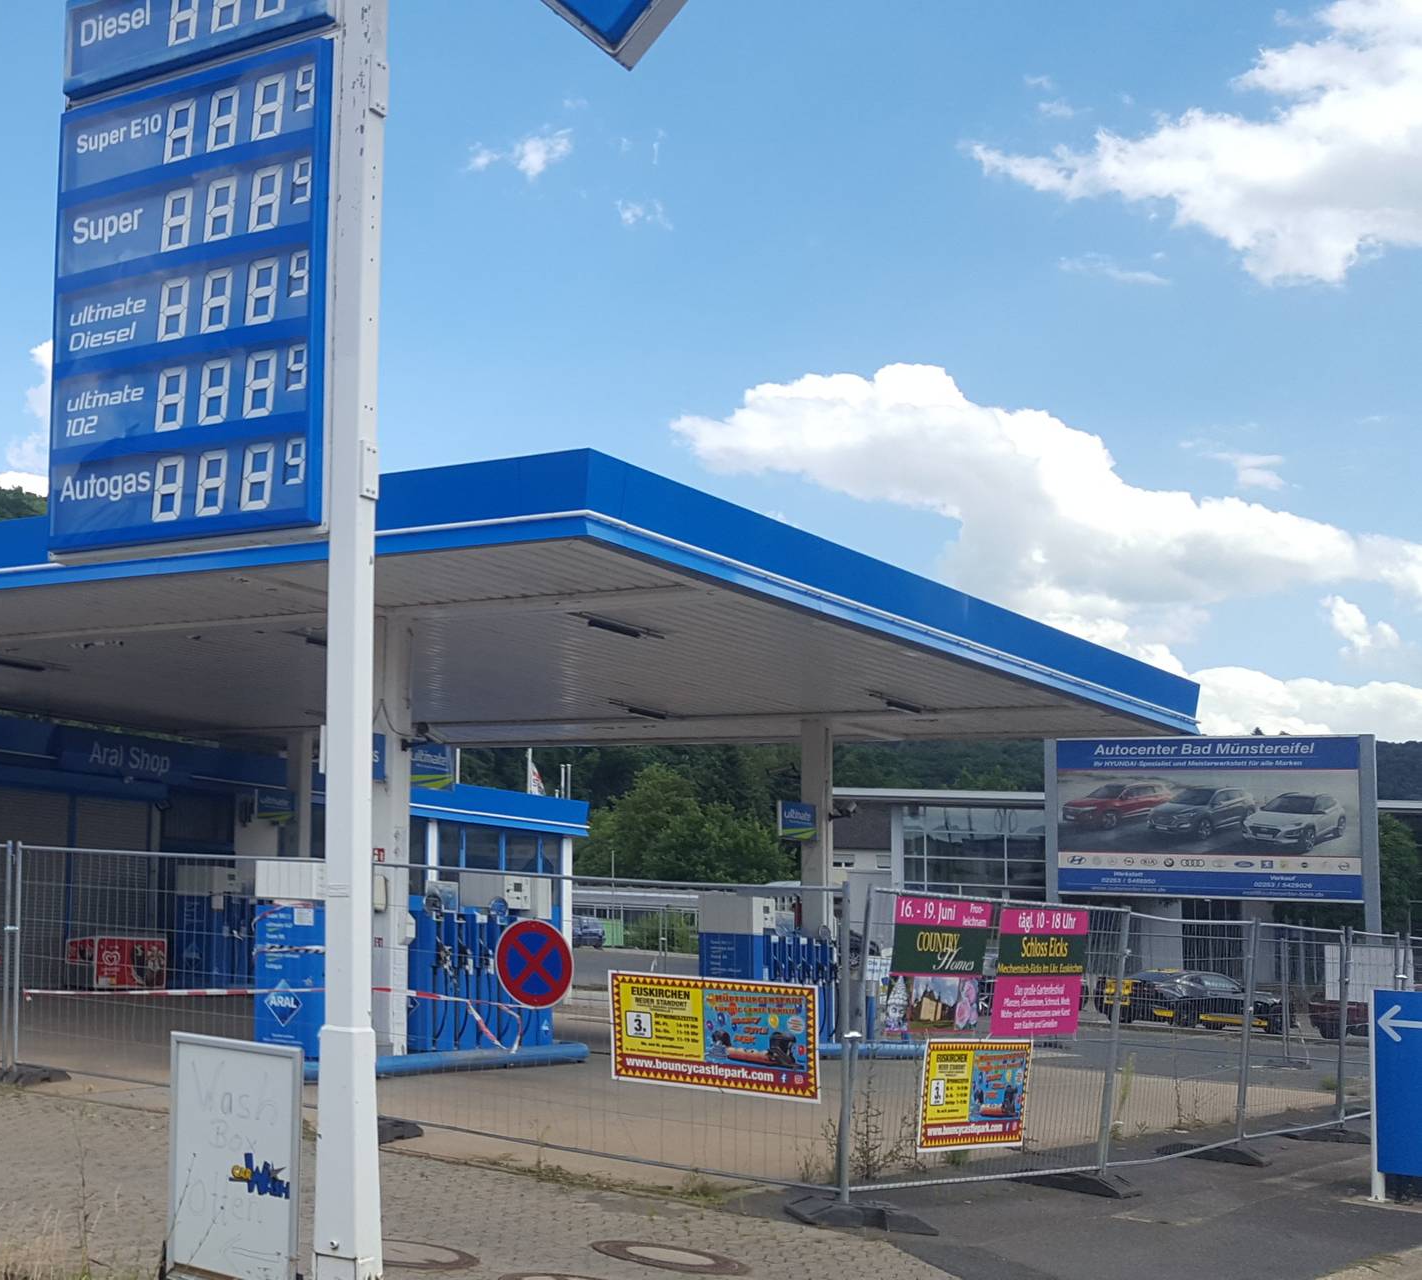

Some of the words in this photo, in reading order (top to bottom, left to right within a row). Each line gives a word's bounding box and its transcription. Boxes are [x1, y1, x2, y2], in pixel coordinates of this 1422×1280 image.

[80, 1, 151, 47] Diesel
[76, 124, 127, 154] Super
[130, 114, 162, 140] E10
[72, 208, 143, 244] Super
[69, 297, 147, 327] ultimate
[68, 322, 137, 352] Diesel
[66, 385, 144, 413] ultimate
[65, 415, 99, 438] 102
[60, 470, 151, 502] Autogas
[89, 741, 124, 767] Aral
[128, 746, 170, 776] Shop
[1094, 743, 1178, 756] Autocenter
[1181, 743, 1212, 755] Bad
[1215, 741, 1315, 755] Münstereifel
[900, 900, 914, 918] 16.
[924, 901, 935, 919] 19.
[937, 902, 956, 924] Juni
[1036, 912, 1045, 928] 10
[1051, 912, 1061, 929] 18
[1062, 913, 1076, 929] Uhr
[916, 931, 960, 952] COUNTRY
[1021, 936, 1048, 957] Schloss
[932, 947, 974, 971] Homes
[269, 995, 297, 1009] ARAL
[631, 986, 690, 1000] EUSKIRCHEN
[634, 1019, 646, 1032] 3.
[626, 1057, 774, 1082] www.bouncycastlepark.com
